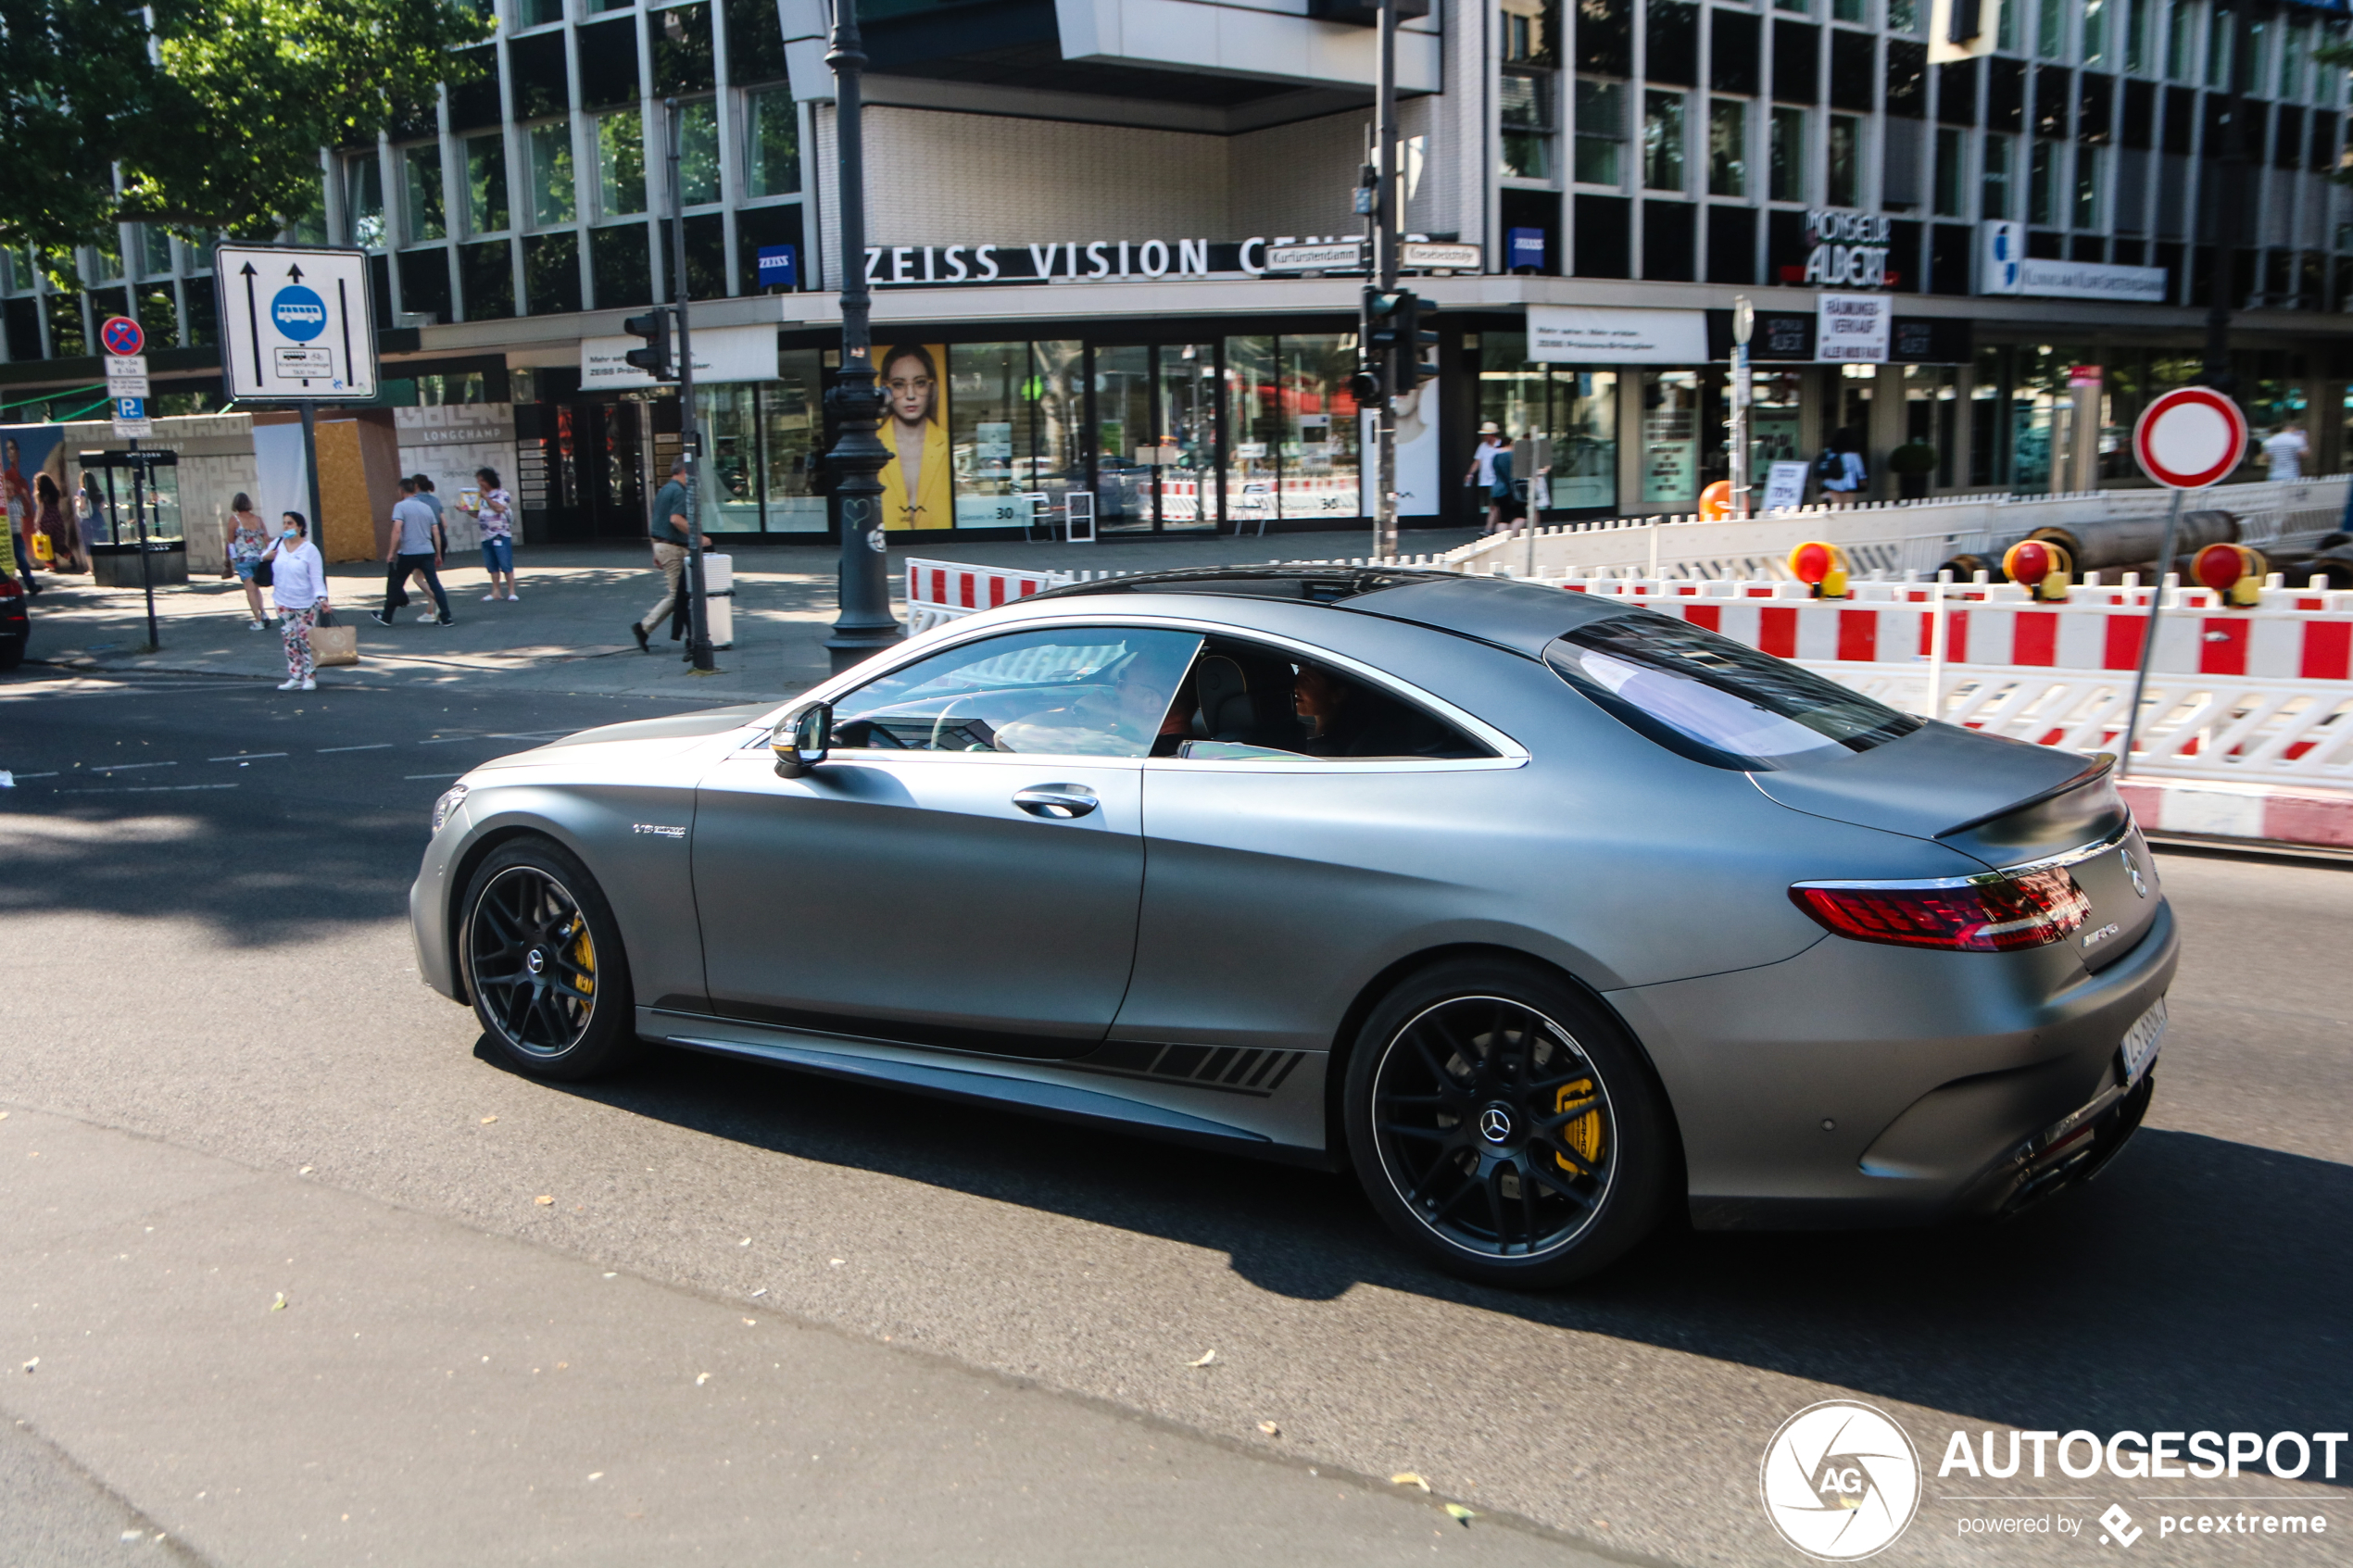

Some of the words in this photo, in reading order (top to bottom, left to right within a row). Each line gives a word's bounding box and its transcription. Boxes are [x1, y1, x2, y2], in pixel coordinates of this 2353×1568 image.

[759, 256, 789, 269] ZEISS
[863, 245, 1000, 284] ZEISS
[1028, 239, 1207, 279] VISION
[589, 367, 615, 376] ZEISS
[120, 398, 135, 416] P
[423, 427, 502, 442] LONGCHAMP
[996, 507, 1013, 520] 30
